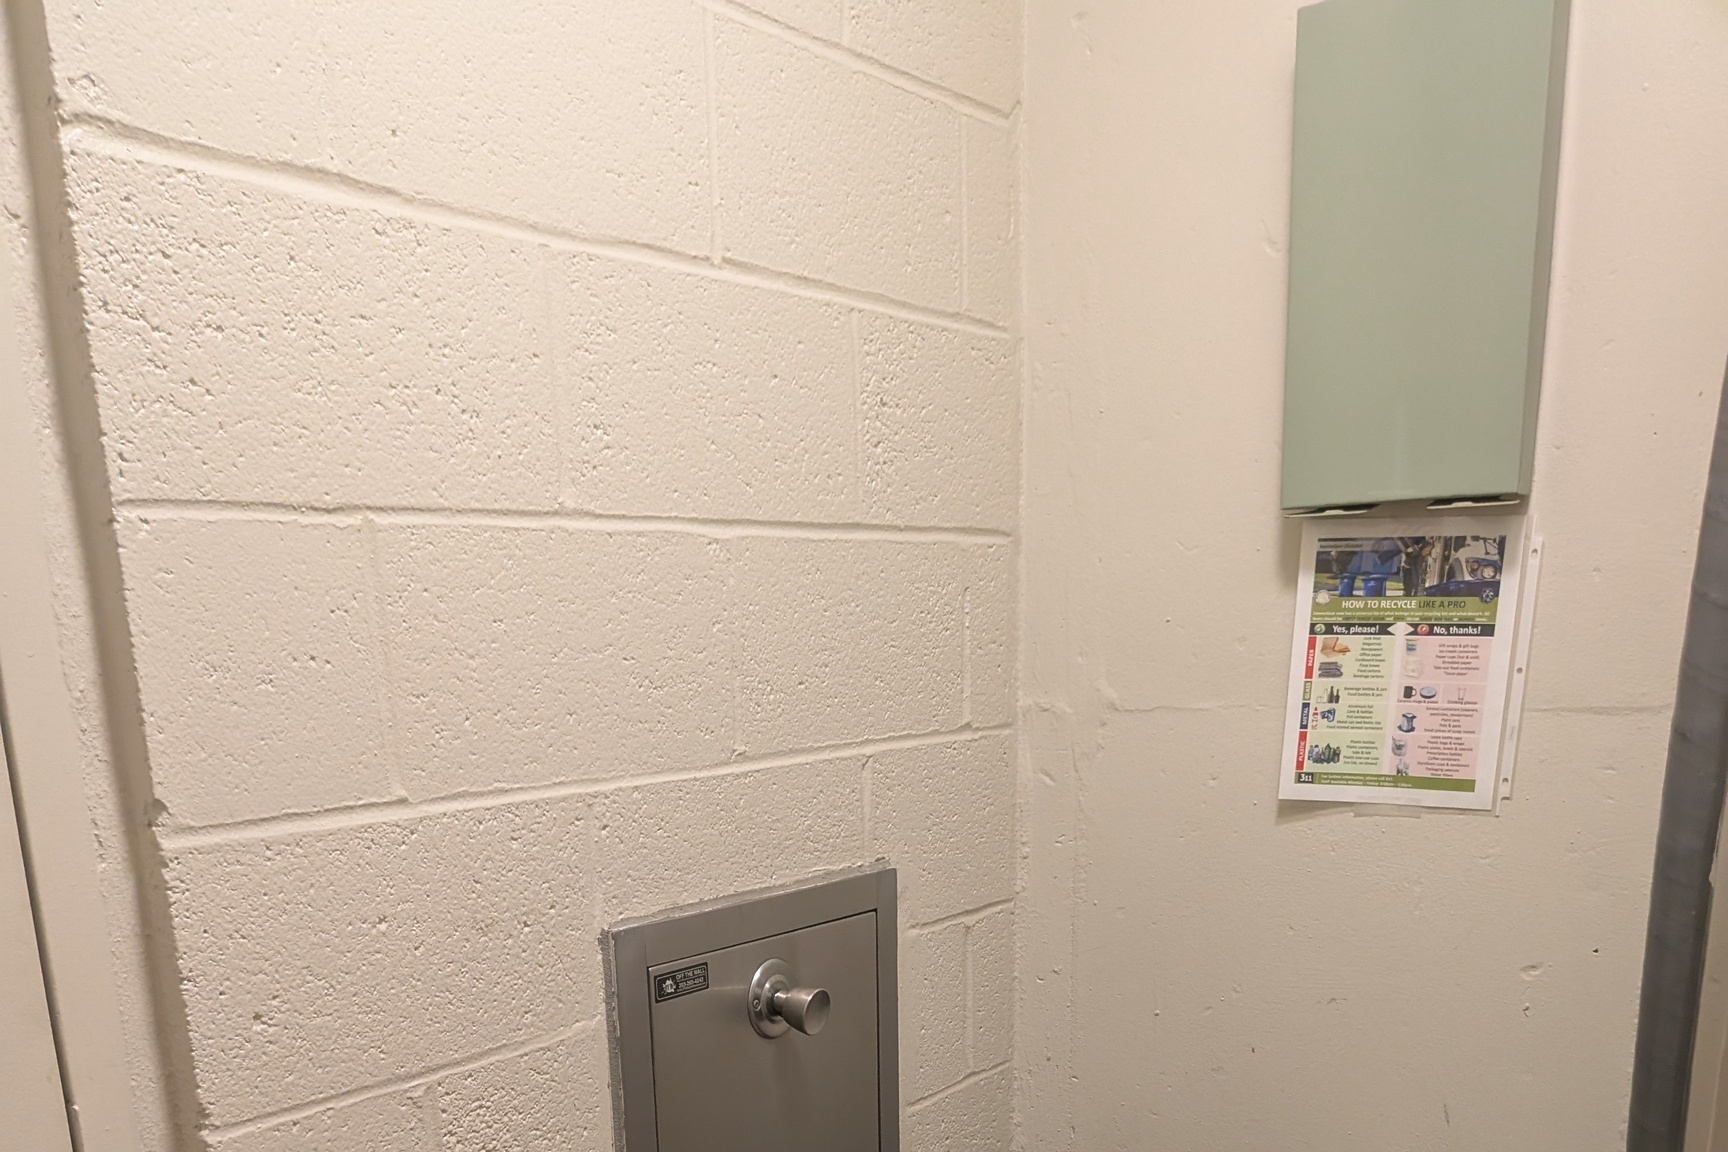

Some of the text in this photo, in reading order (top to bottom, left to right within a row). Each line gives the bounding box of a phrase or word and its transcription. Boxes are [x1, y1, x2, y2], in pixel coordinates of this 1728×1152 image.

[1341, 600, 1466, 609] HOW TO RECYCLE LIKE A PRO
[1333, 625, 1380, 634] Yes, please!
[1433, 626, 1482, 635] No, thanks!
[1299, 773, 1312, 782] 311
